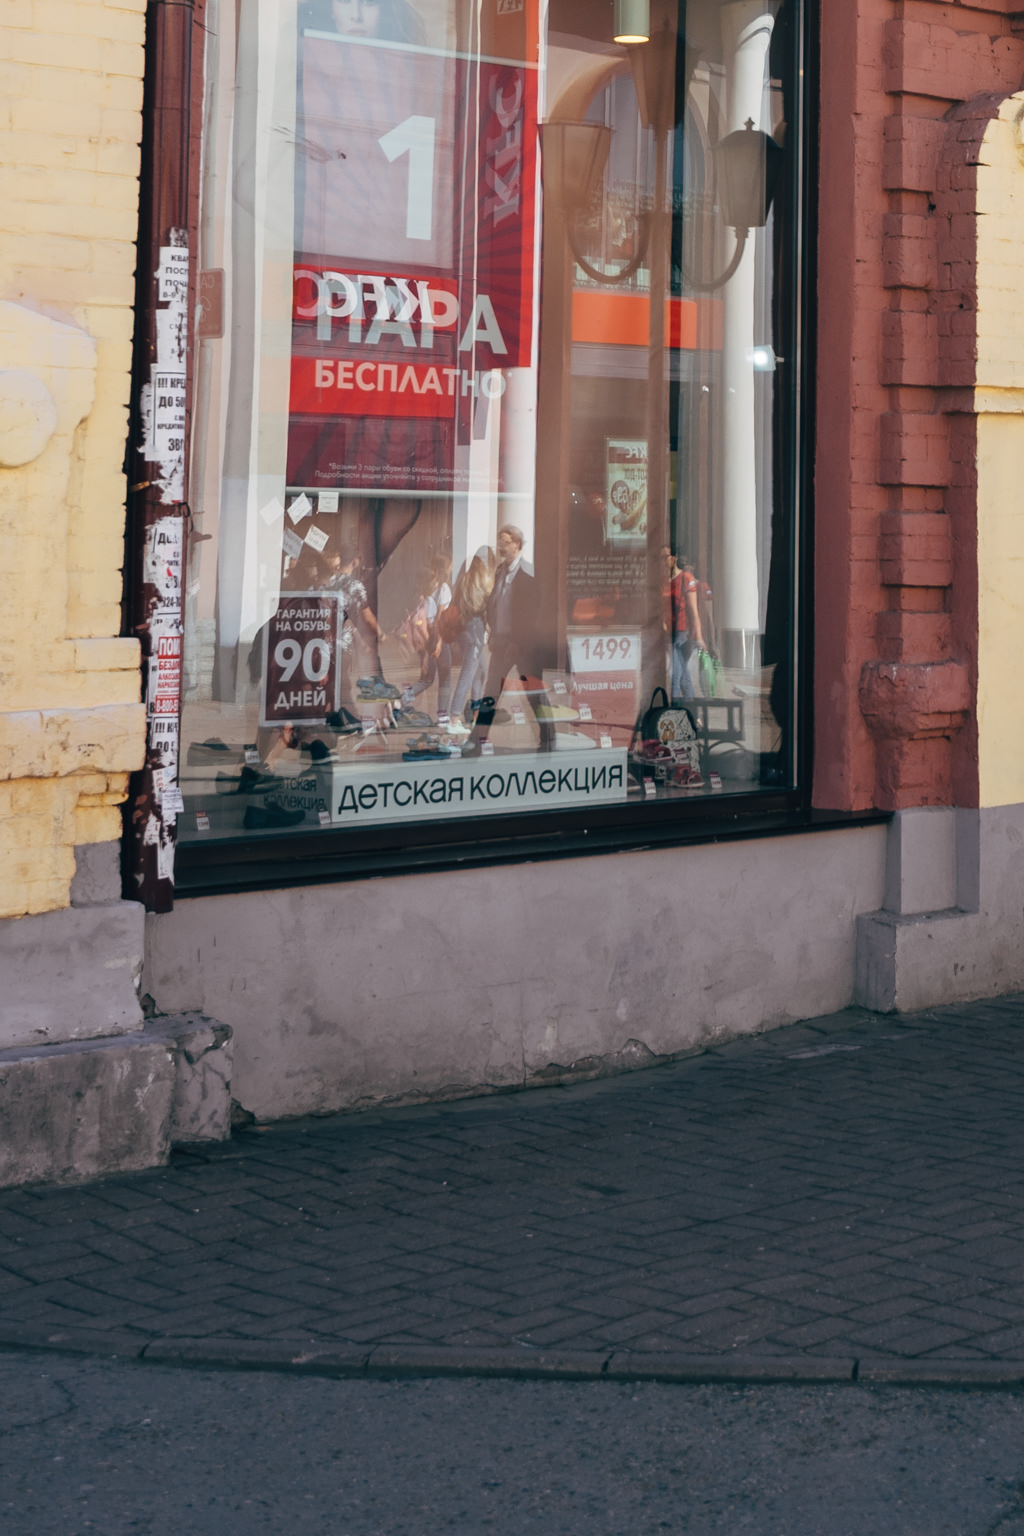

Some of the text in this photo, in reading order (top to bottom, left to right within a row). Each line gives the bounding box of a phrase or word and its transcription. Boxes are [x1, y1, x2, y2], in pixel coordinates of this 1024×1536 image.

[377, 115, 437, 241] 1
[316, 278, 508, 355] ПАРА
[275, 608, 332, 619] ГАРАНТИЯ
[275, 620, 331, 632] НА ОБУВЬ
[274, 638, 331, 682] 90
[581, 637, 631, 661] 1499
[273, 686, 327, 711] ДНЕЙ
[338, 764, 623, 816] детская коллекция
